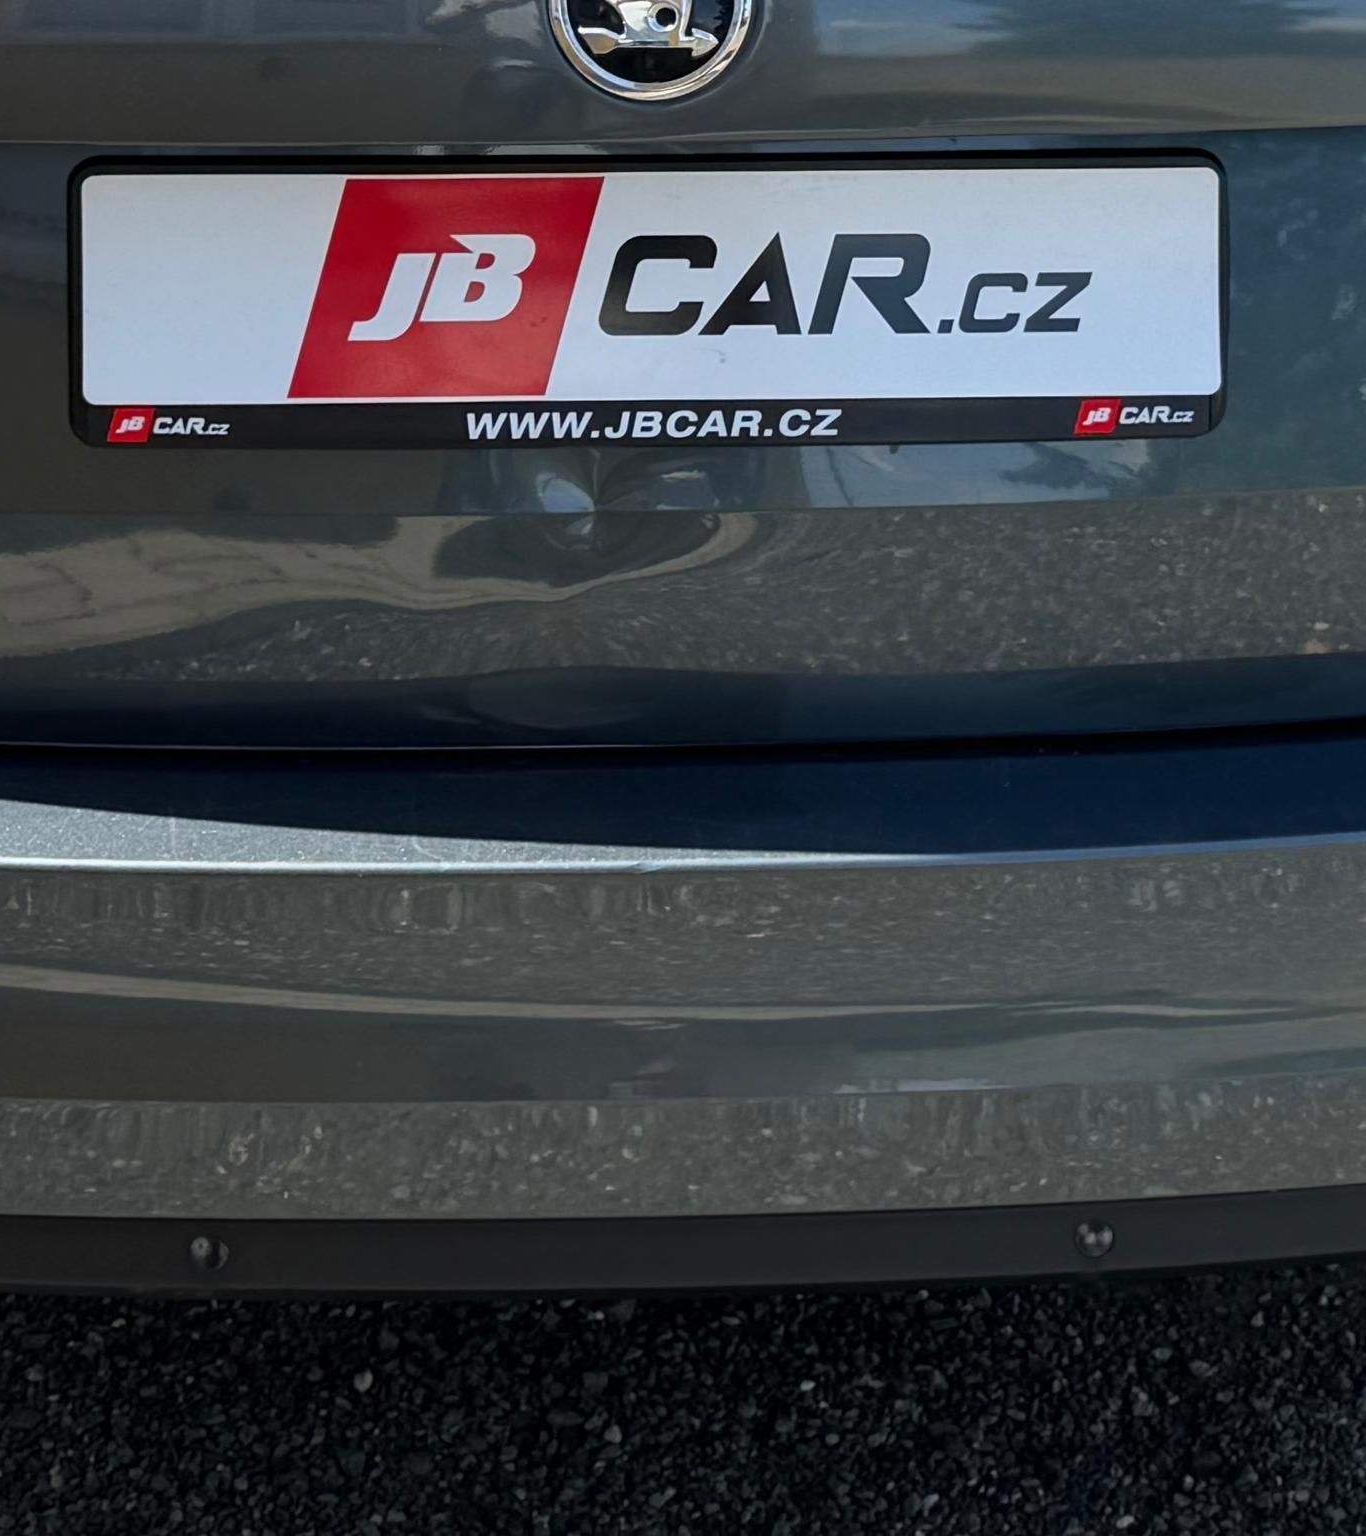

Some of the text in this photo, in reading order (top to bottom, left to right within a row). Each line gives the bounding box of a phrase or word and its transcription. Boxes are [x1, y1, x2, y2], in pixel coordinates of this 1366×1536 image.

[348, 233, 535, 342] JB
[115, 416, 145, 433] JB
[466, 409, 842, 439] WWW.JBCAR.CZ
[1082, 407, 1111, 425] JB
